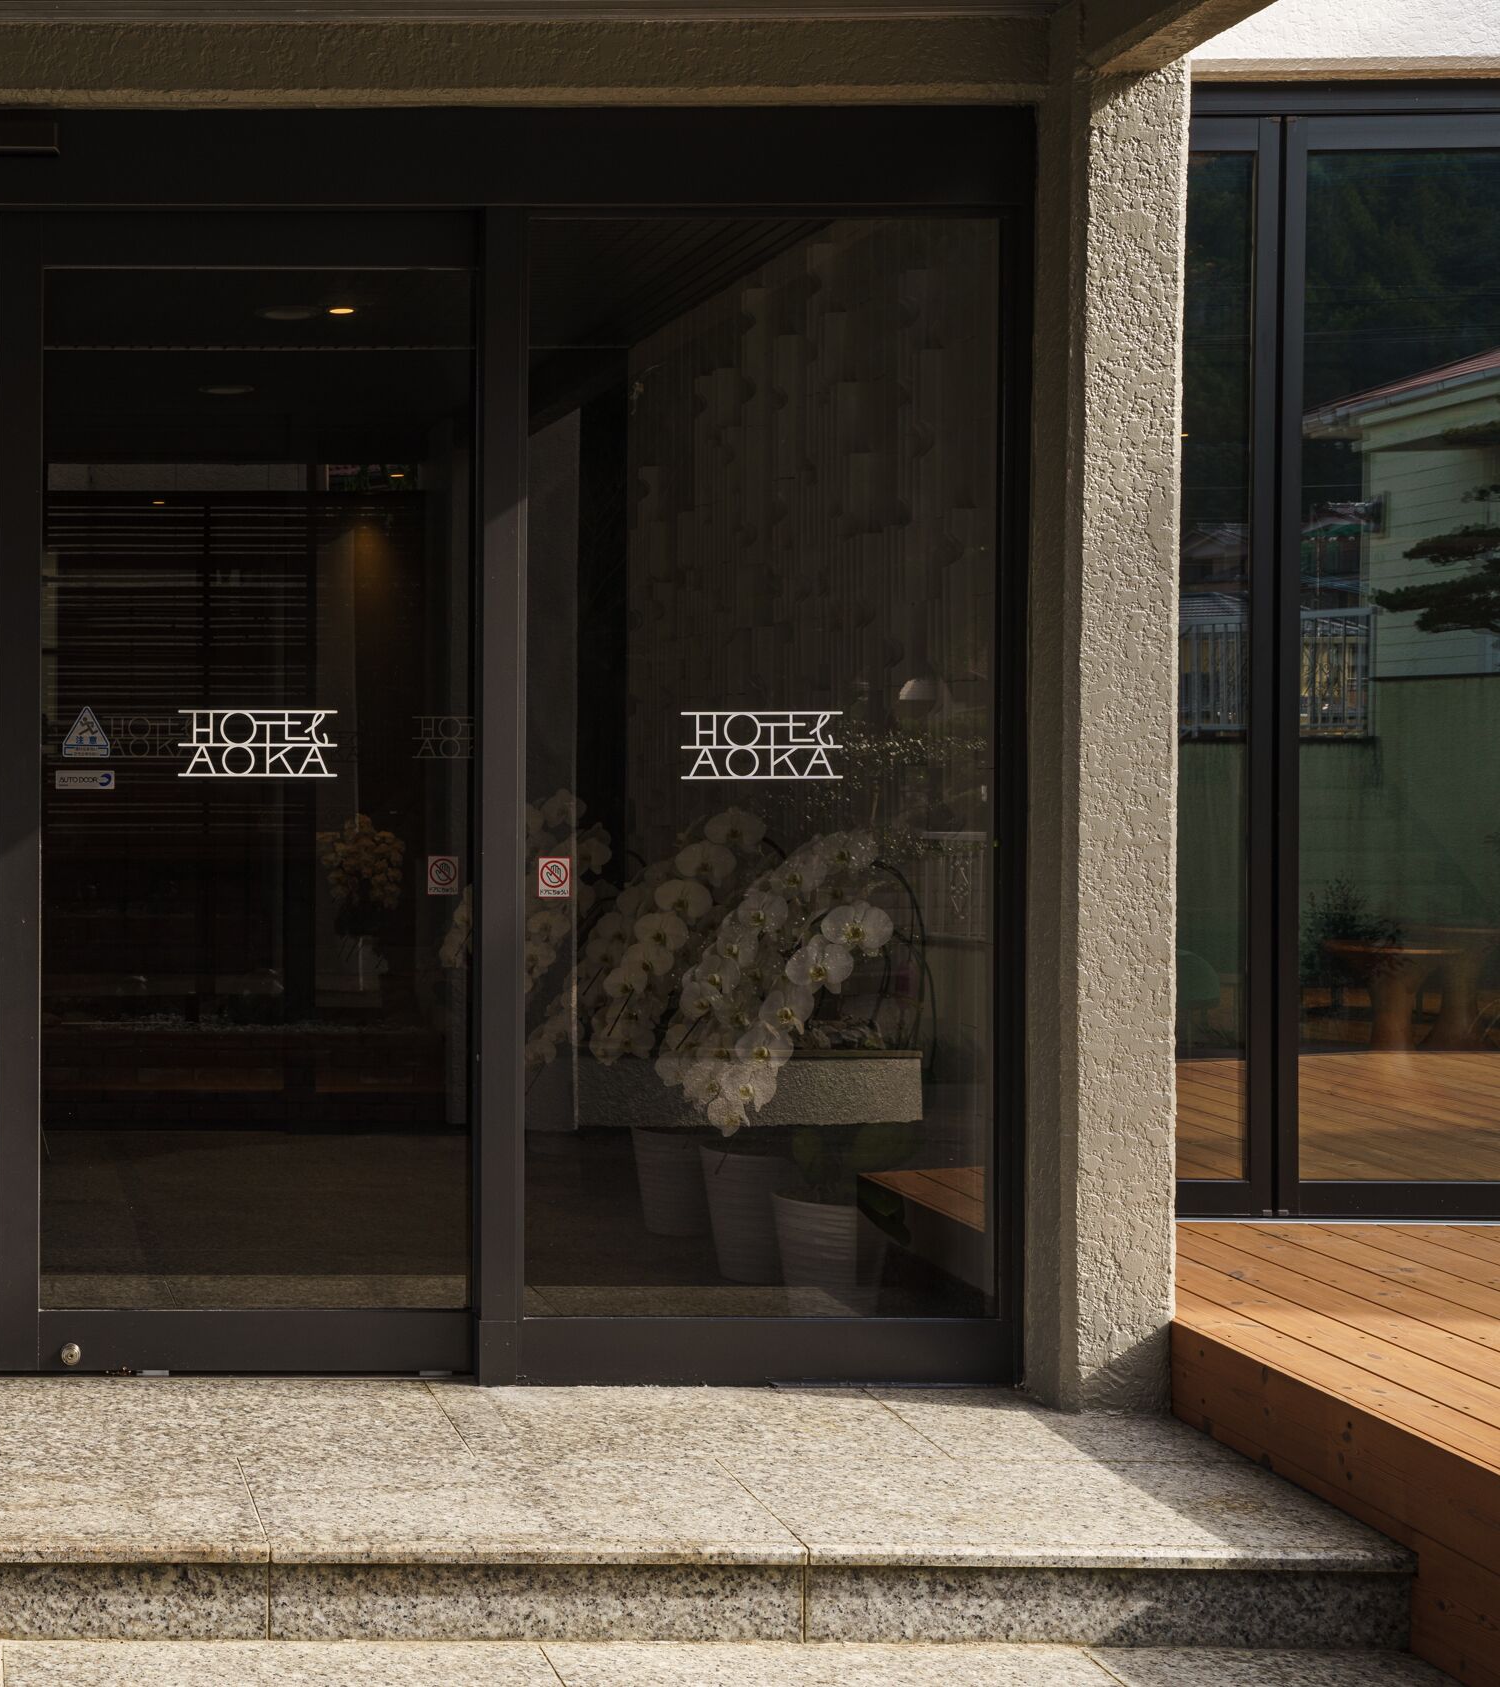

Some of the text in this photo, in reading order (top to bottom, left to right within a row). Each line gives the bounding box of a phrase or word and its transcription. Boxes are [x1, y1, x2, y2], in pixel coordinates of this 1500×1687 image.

[75, 735, 98, 745] 注意
[185, 746, 329, 777] AOKA
[689, 747, 834, 779] AOKA
